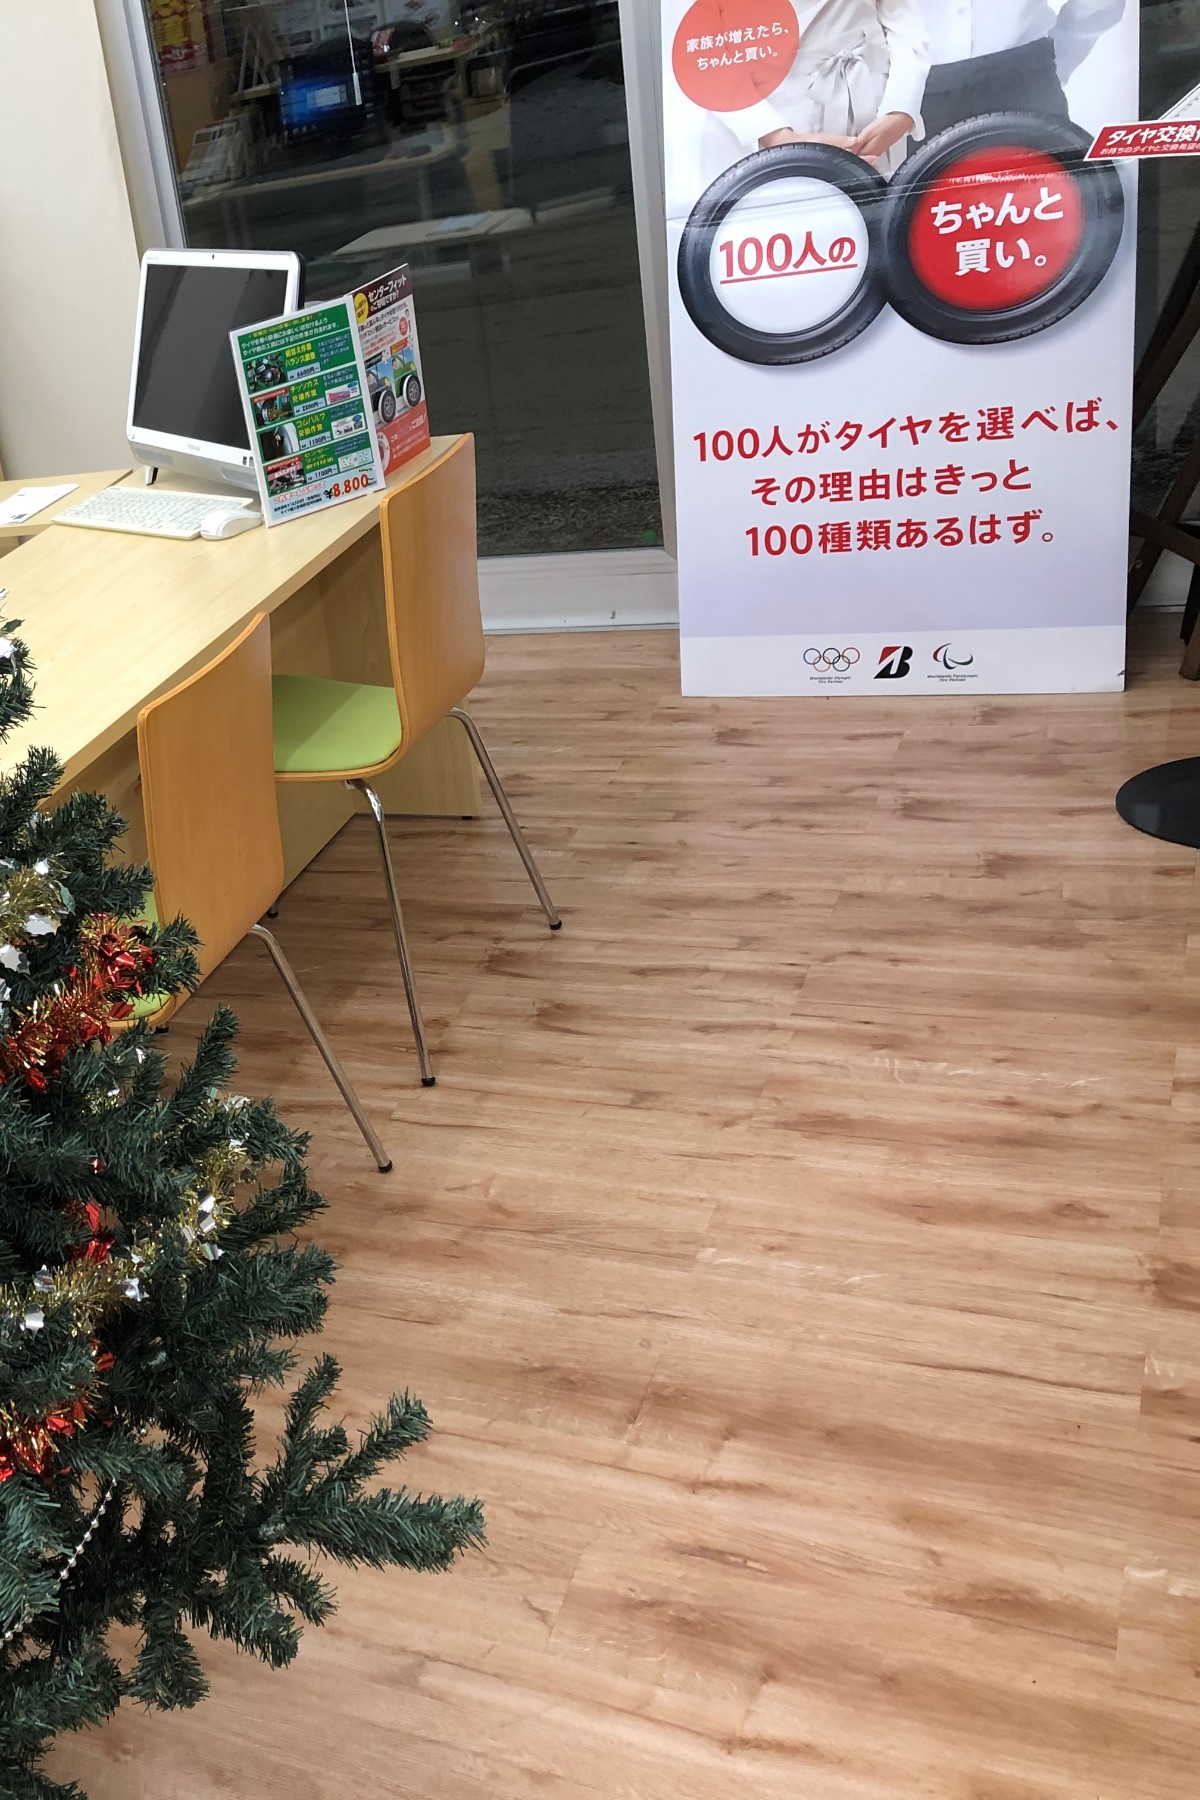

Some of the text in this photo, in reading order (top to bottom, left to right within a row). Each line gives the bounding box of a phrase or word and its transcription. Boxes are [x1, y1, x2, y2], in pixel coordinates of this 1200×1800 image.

[686, 22, 789, 53] 家族が増えたら、
[696, 46, 778, 71] ちゃんと買い。
[930, 187, 1064, 235] ちゃんと
[719, 230, 856, 278] 100人の
[955, 238, 1047, 277] 買い。
[368, 273, 407, 301] センターフィット
[693, 396, 1118, 463] 100人がタイヤを選べば、
[750, 459, 1033, 505] その理由はきっと
[744, 508, 1055, 557] 100種類あるはず。
